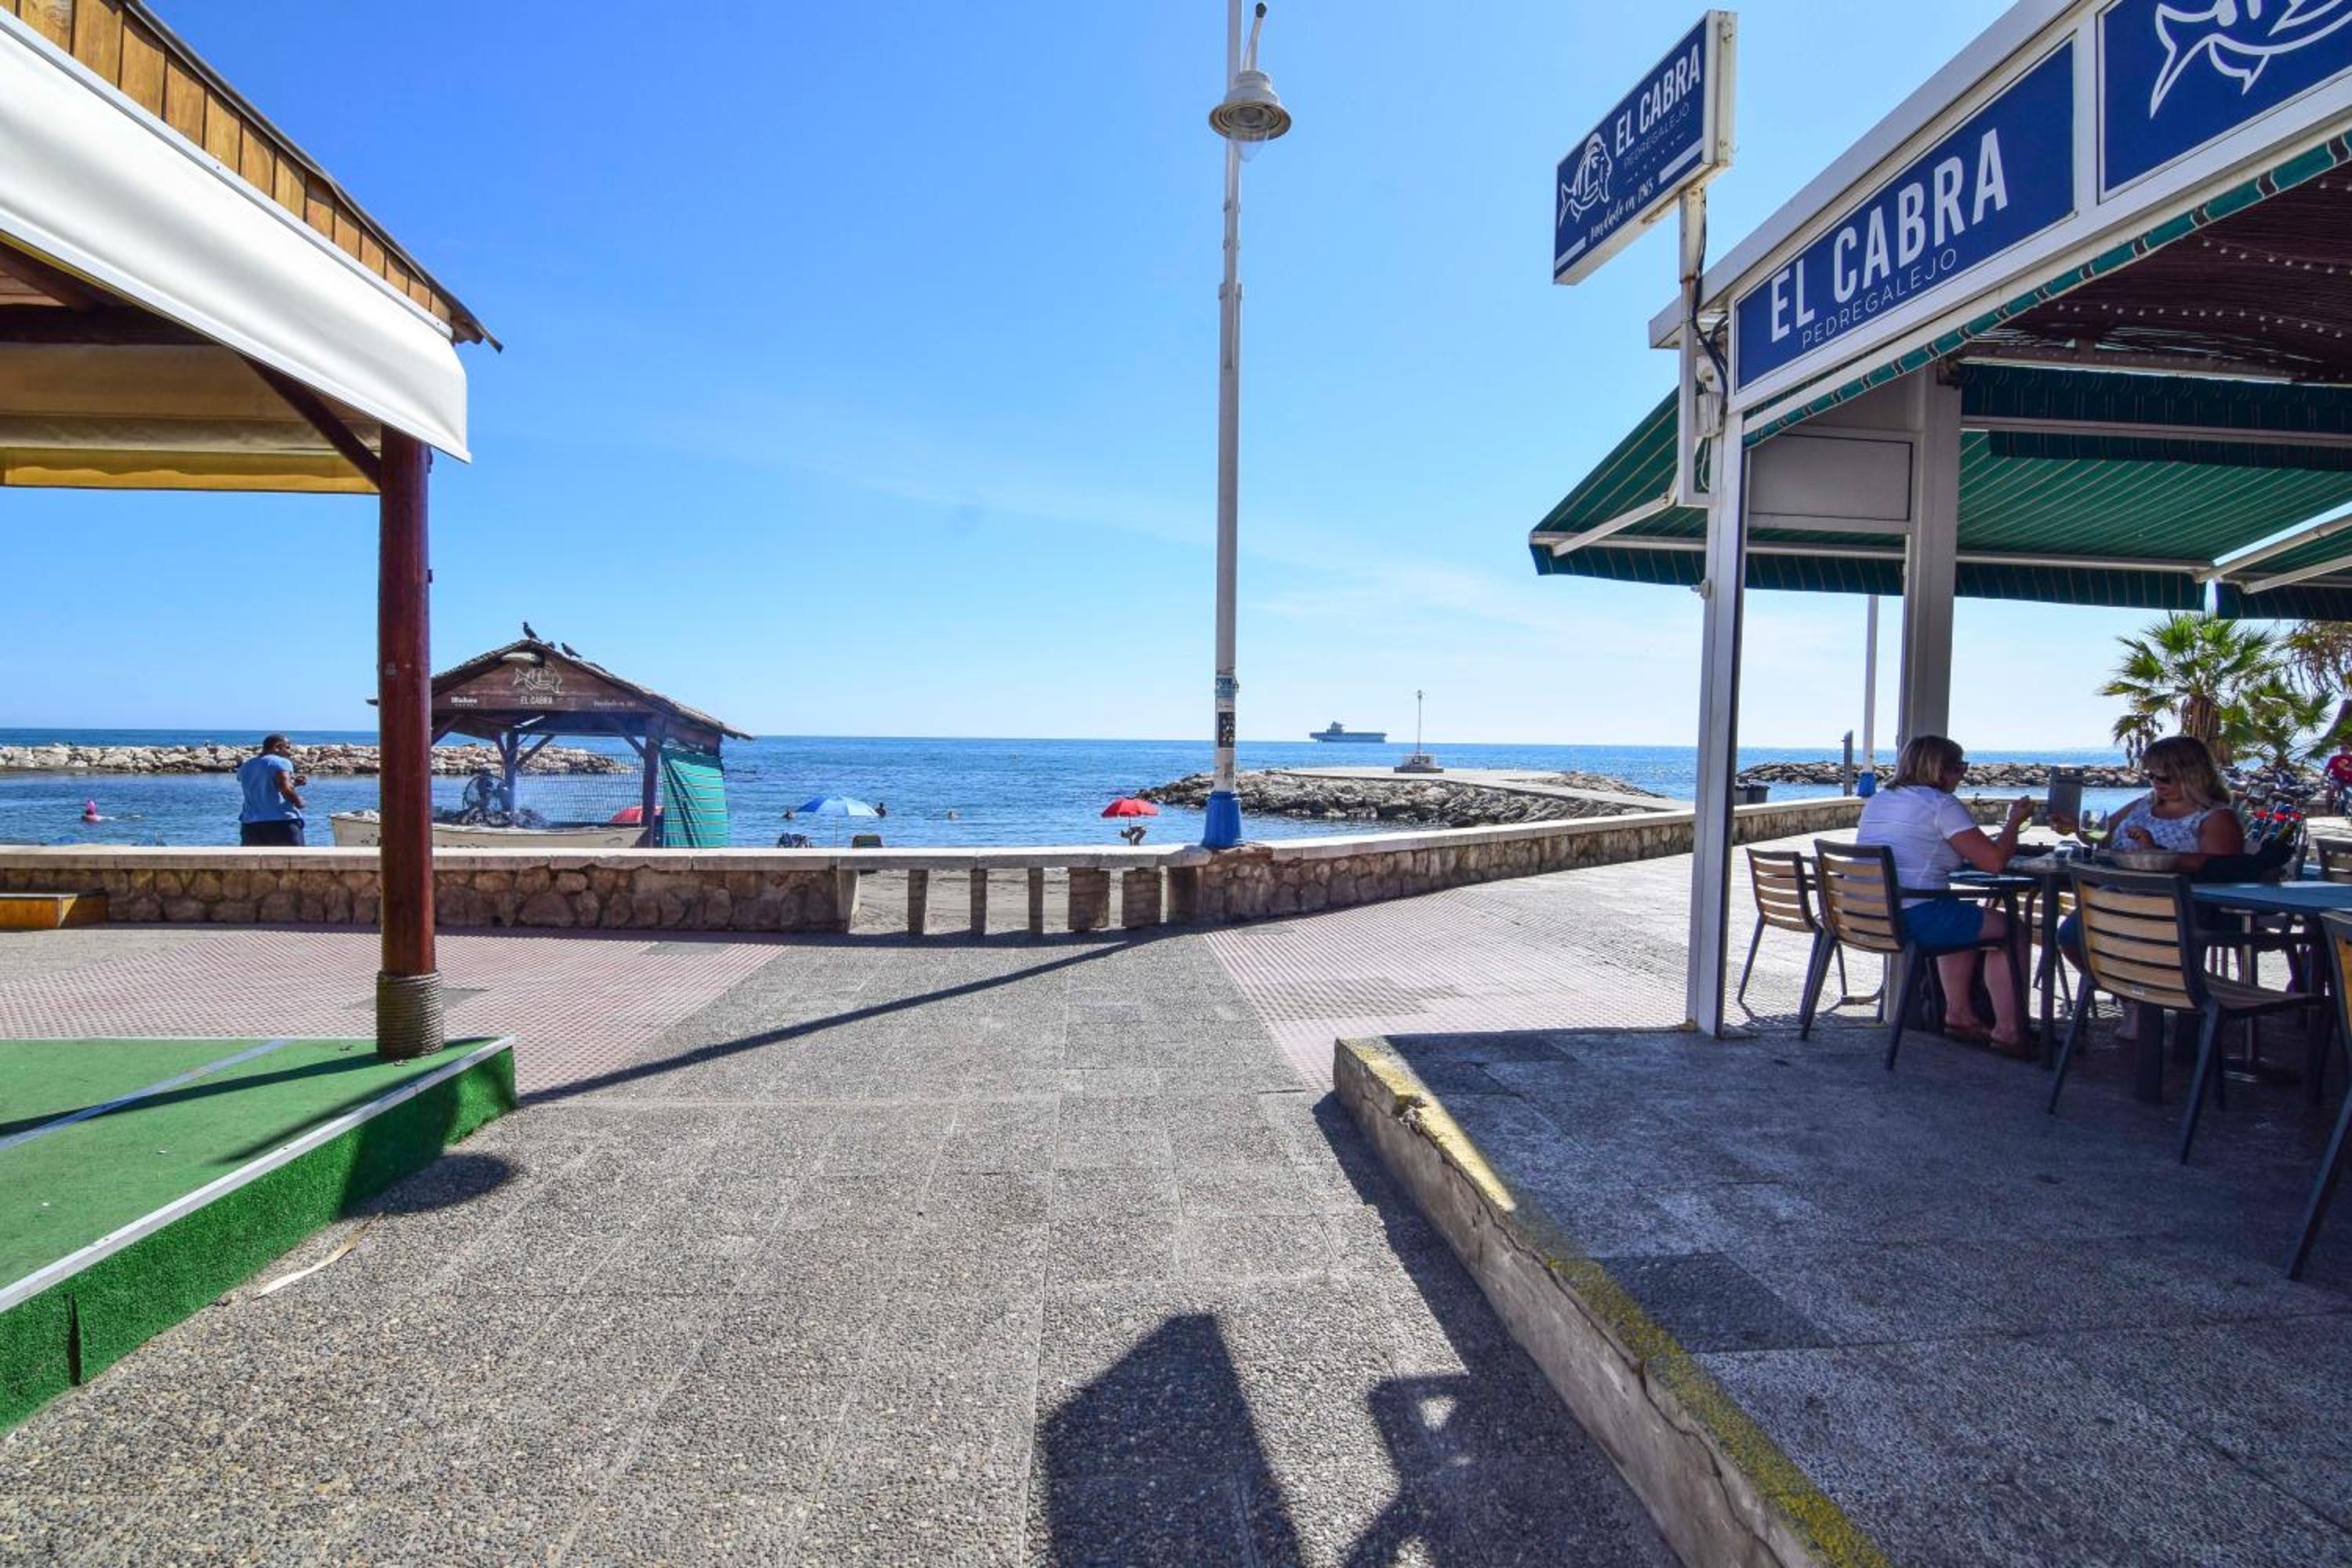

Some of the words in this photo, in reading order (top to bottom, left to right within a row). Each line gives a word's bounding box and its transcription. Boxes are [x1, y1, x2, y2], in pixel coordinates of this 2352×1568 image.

[1616, 108, 1635, 158] EL
[1639, 42, 1701, 133] CABRA
[1770, 258, 1815, 343] EL
[1833, 127, 2008, 304] CABRA
[1802, 248, 1957, 349] PEDREGALEJO
[521, 695, 528, 705] EL
[531, 695, 553, 705] CABRA
